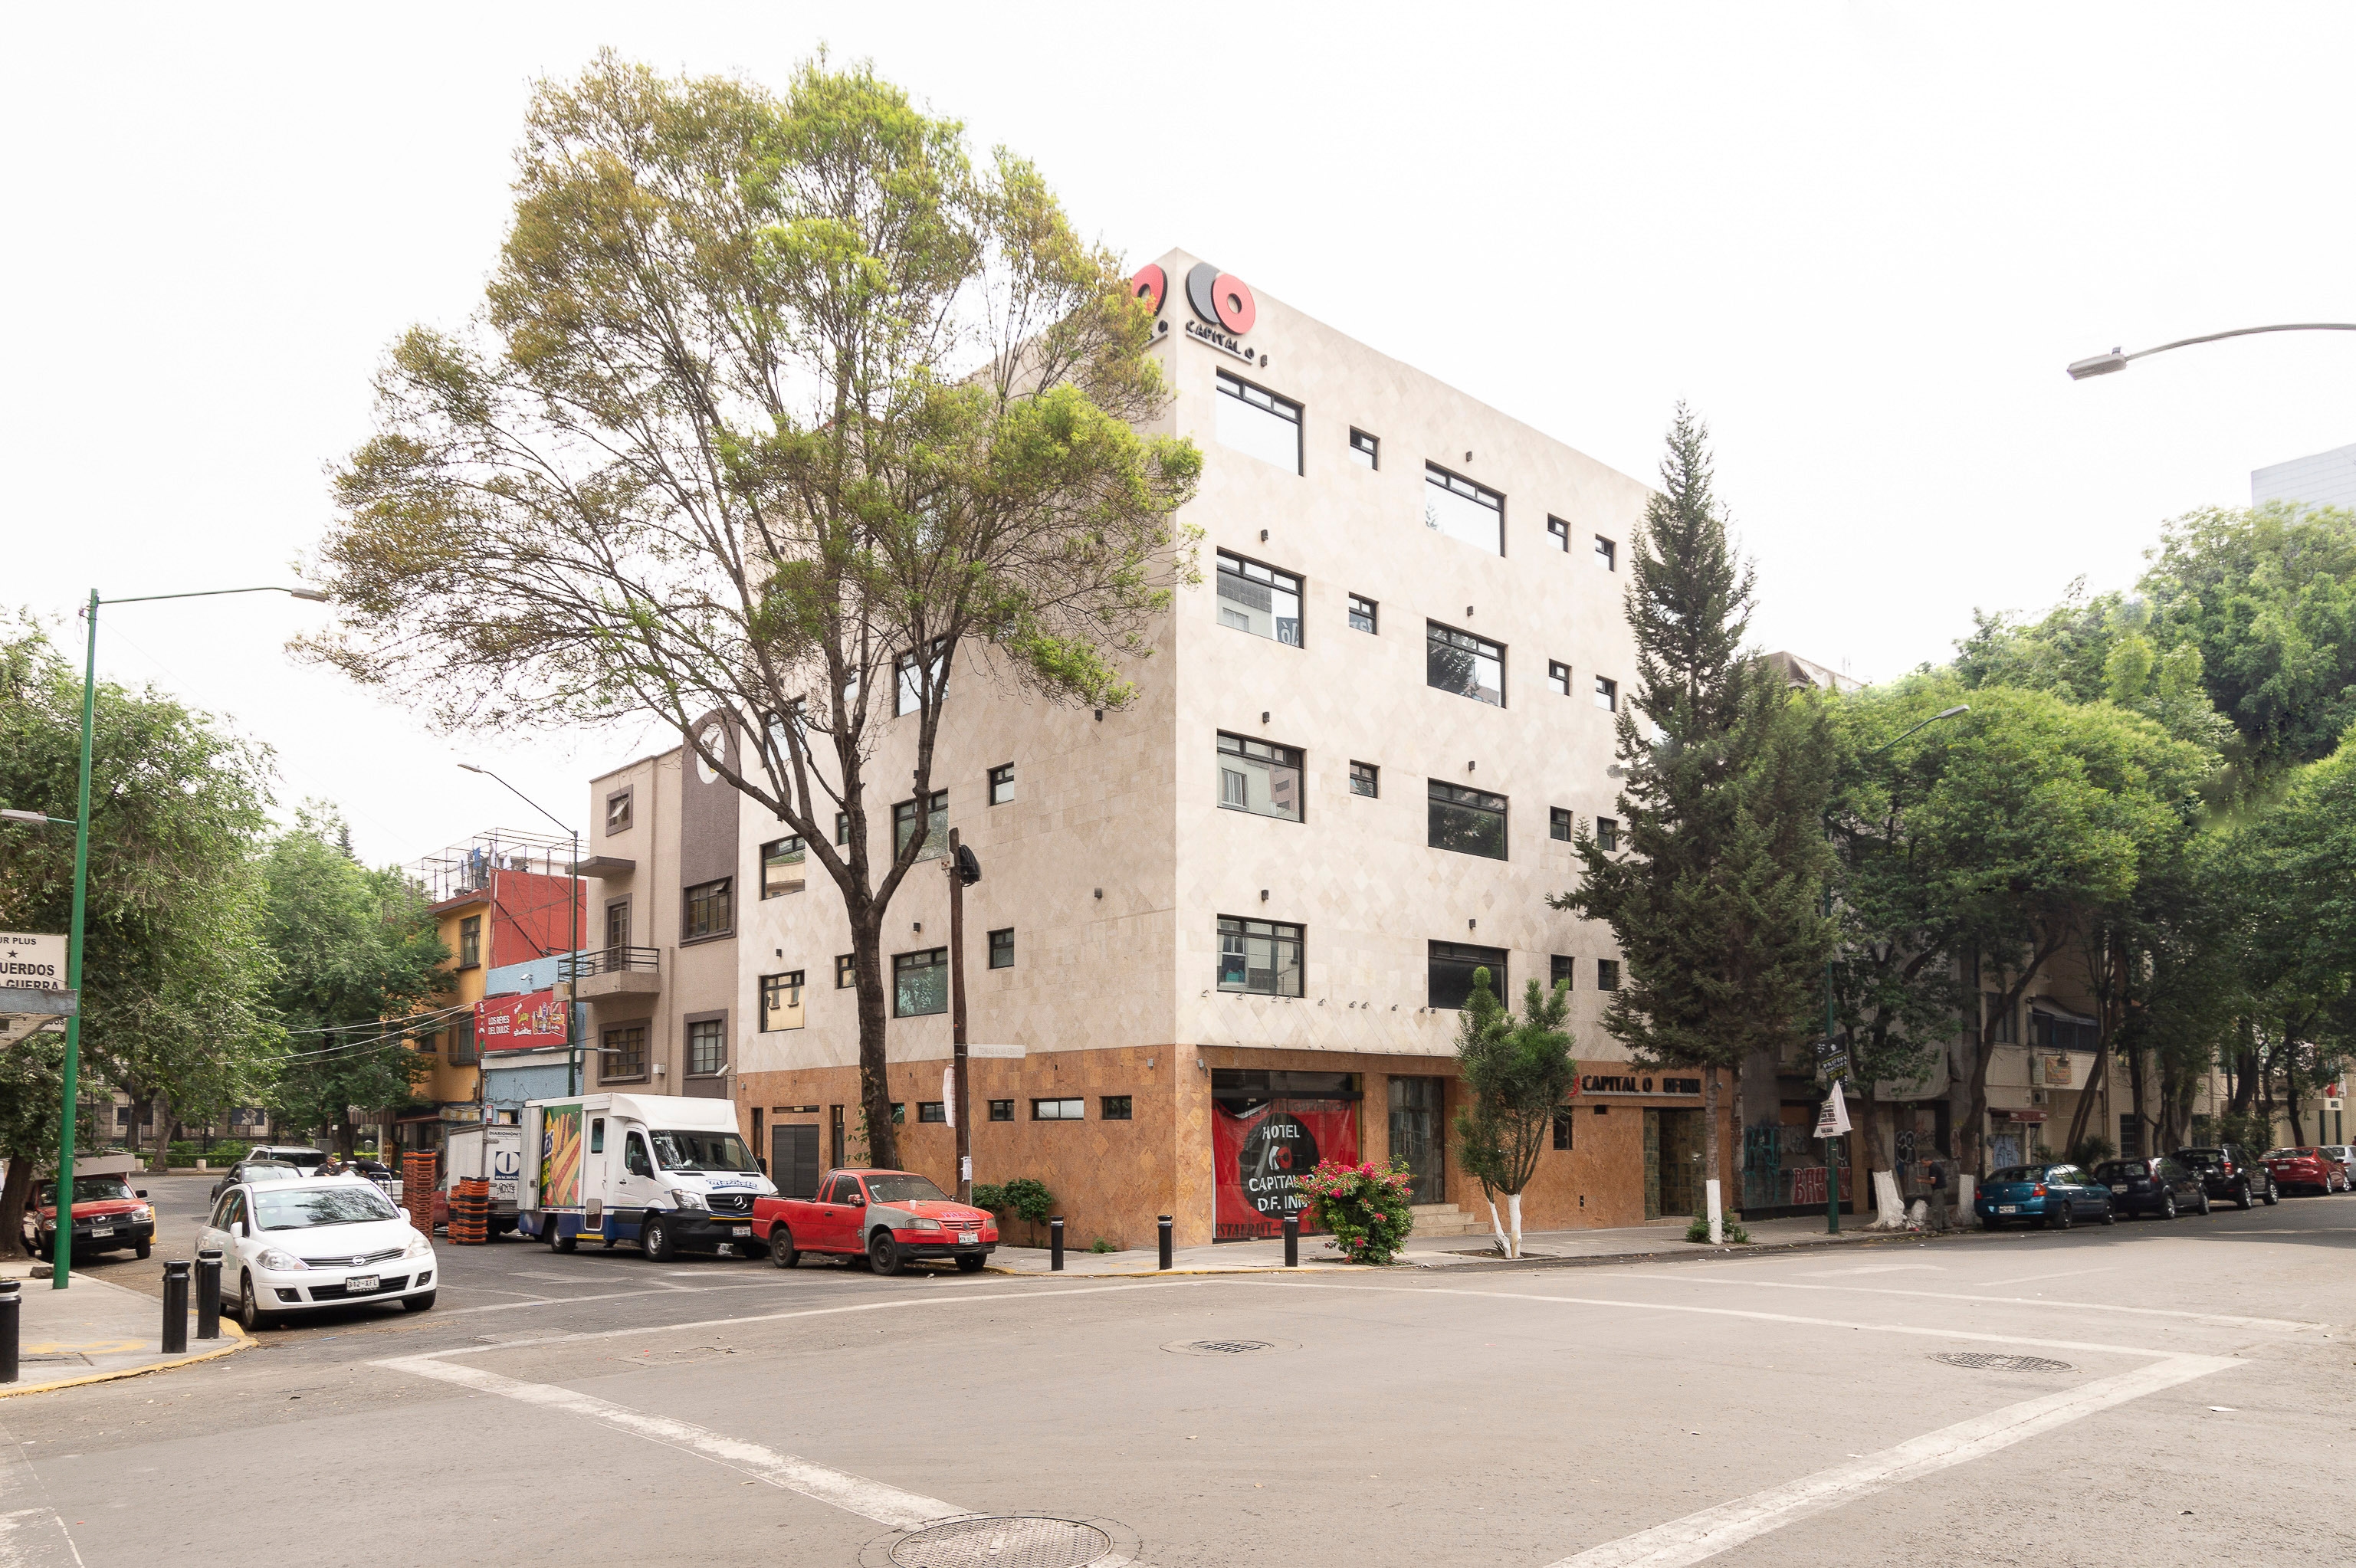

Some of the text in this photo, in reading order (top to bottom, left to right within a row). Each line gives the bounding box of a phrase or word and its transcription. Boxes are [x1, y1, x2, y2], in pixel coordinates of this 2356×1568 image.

[1186, 320, 1255, 359] CAPITAL O
[0, 963, 54, 976] UERDOS
[488, 1015, 510, 1025] LOS REYES
[497, 1025, 510, 1034] DULCE
[1007, 1048, 1025, 1056] EDISO
[1582, 1074, 1640, 1092] CAPITAL
[1642, 1077, 1653, 1093] O
[1262, 1124, 1300, 1140] HOTEL
[1249, 1174, 1301, 1192] CAPITAL
[1257, 1196, 1281, 1212] D.F.
